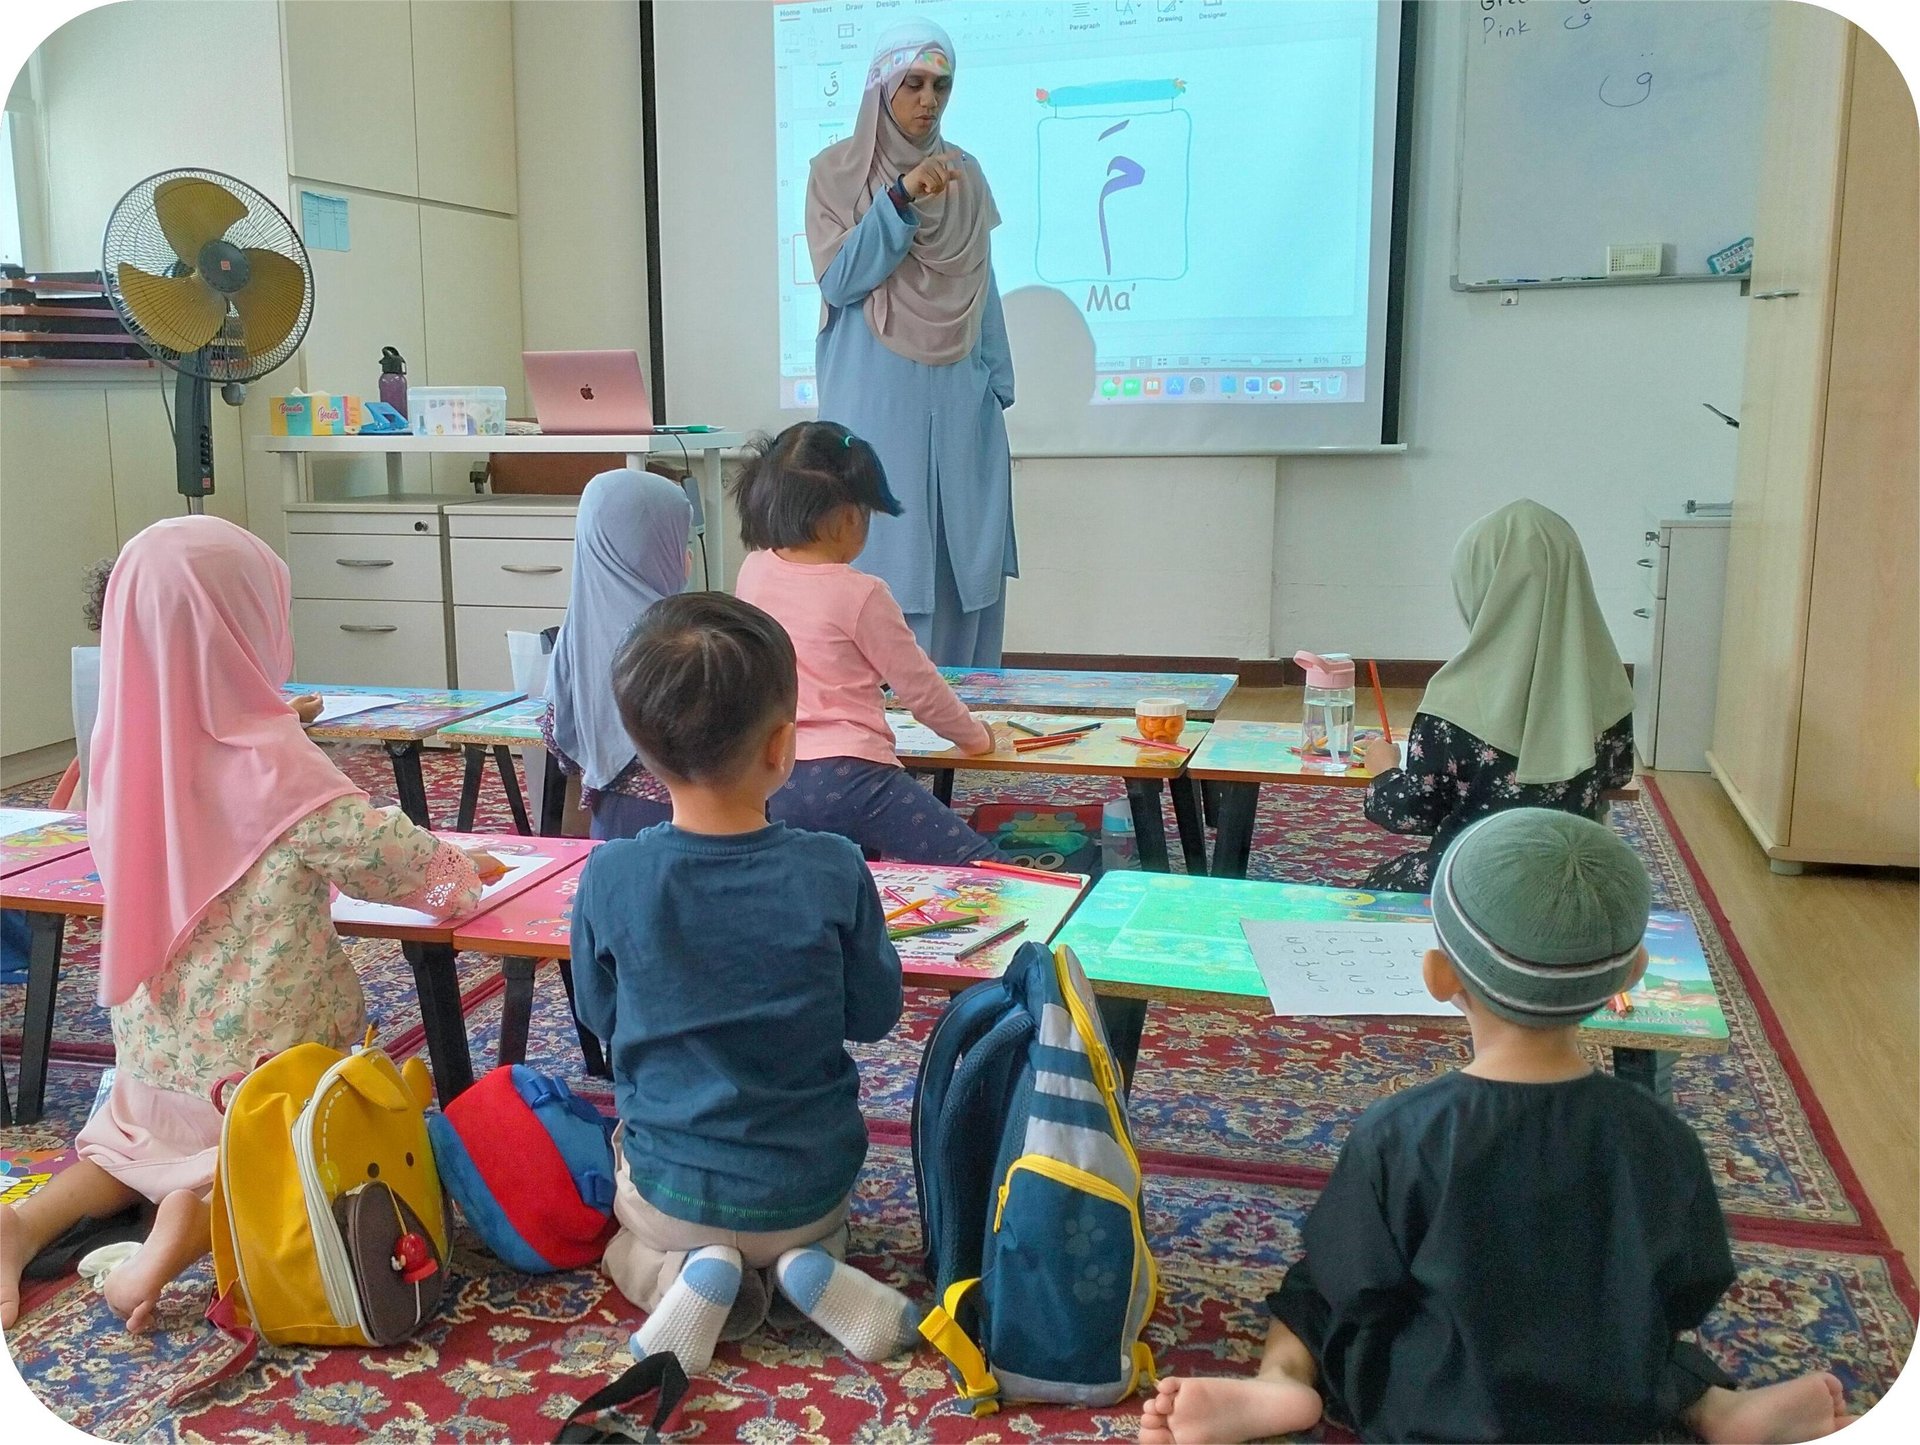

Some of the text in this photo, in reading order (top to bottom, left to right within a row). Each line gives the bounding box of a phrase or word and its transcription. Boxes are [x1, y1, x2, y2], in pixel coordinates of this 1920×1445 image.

[779, 0, 900, 17] Home Insert Draw Design
[1157, 15, 1183, 23] Drawing
[1198, 11, 1228, 20] Designer
[1069, 22, 1101, 31] Paragraph
[1119, 18, 1137, 26] Insert
[1483, 16, 1531, 45] Pink
[1313, 356, 1329, 364] 81%
